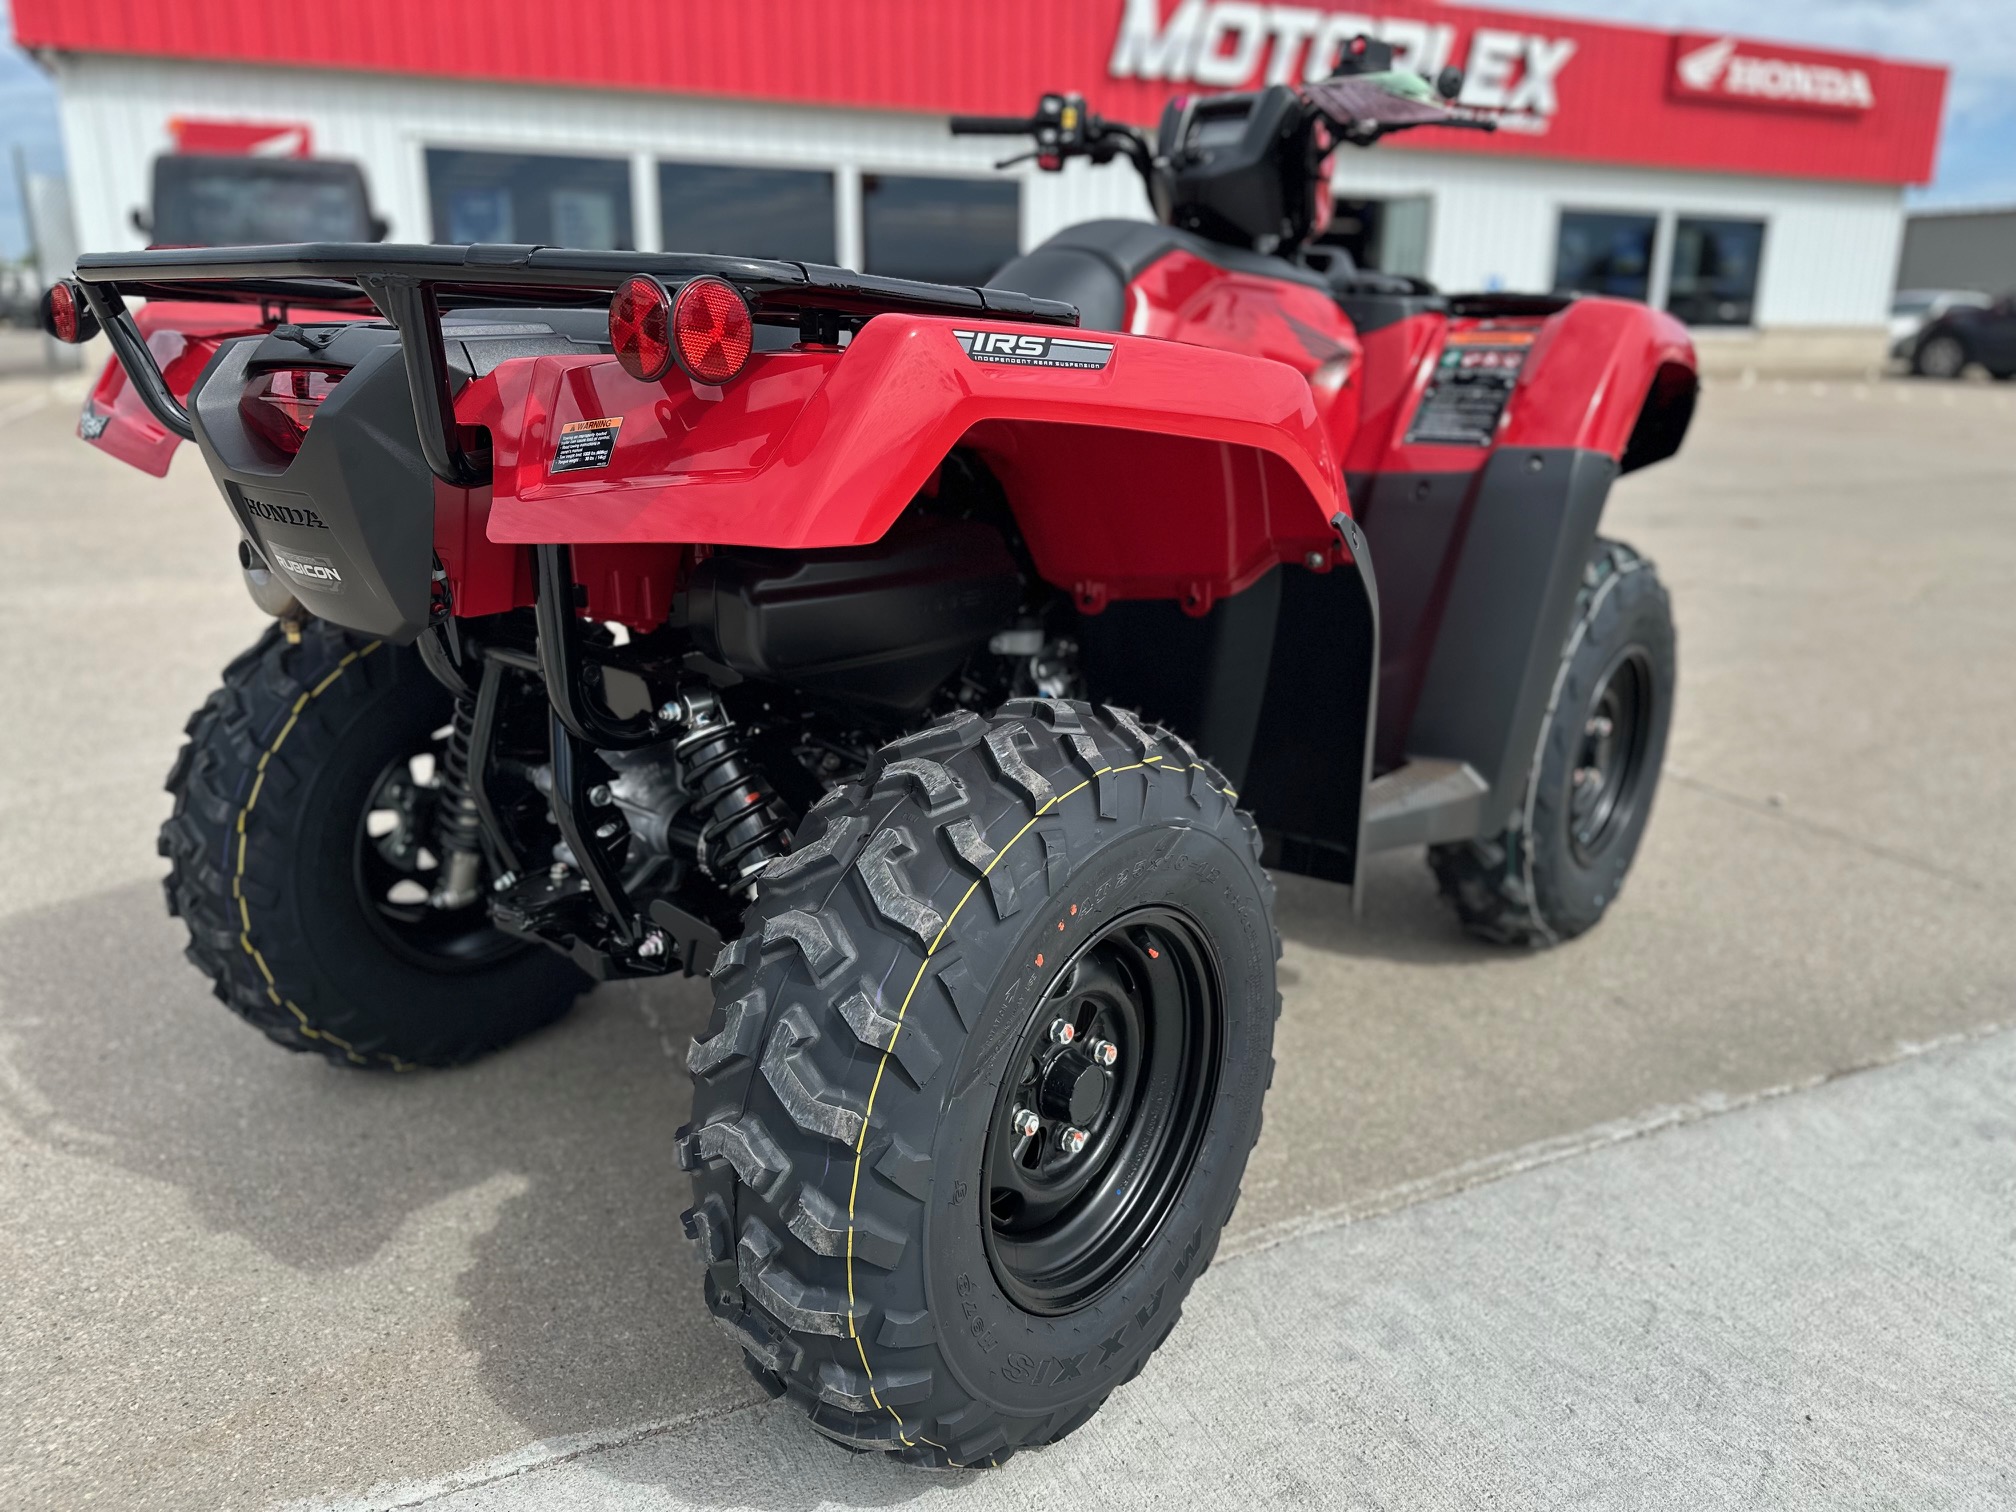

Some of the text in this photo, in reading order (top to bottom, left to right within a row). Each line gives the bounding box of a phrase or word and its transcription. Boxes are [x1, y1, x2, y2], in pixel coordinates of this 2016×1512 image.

[1723, 55, 1875, 109] HONDA
[973, 332, 1046, 356] IRS
[974, 355, 1031, 364] INDEPENDENT
[578, 419, 612, 430] WARNING
[243, 496, 329, 529] HONDA
[274, 554, 342, 581] RUBICON
[1001, 1220, 1204, 1387] MAXXIS
